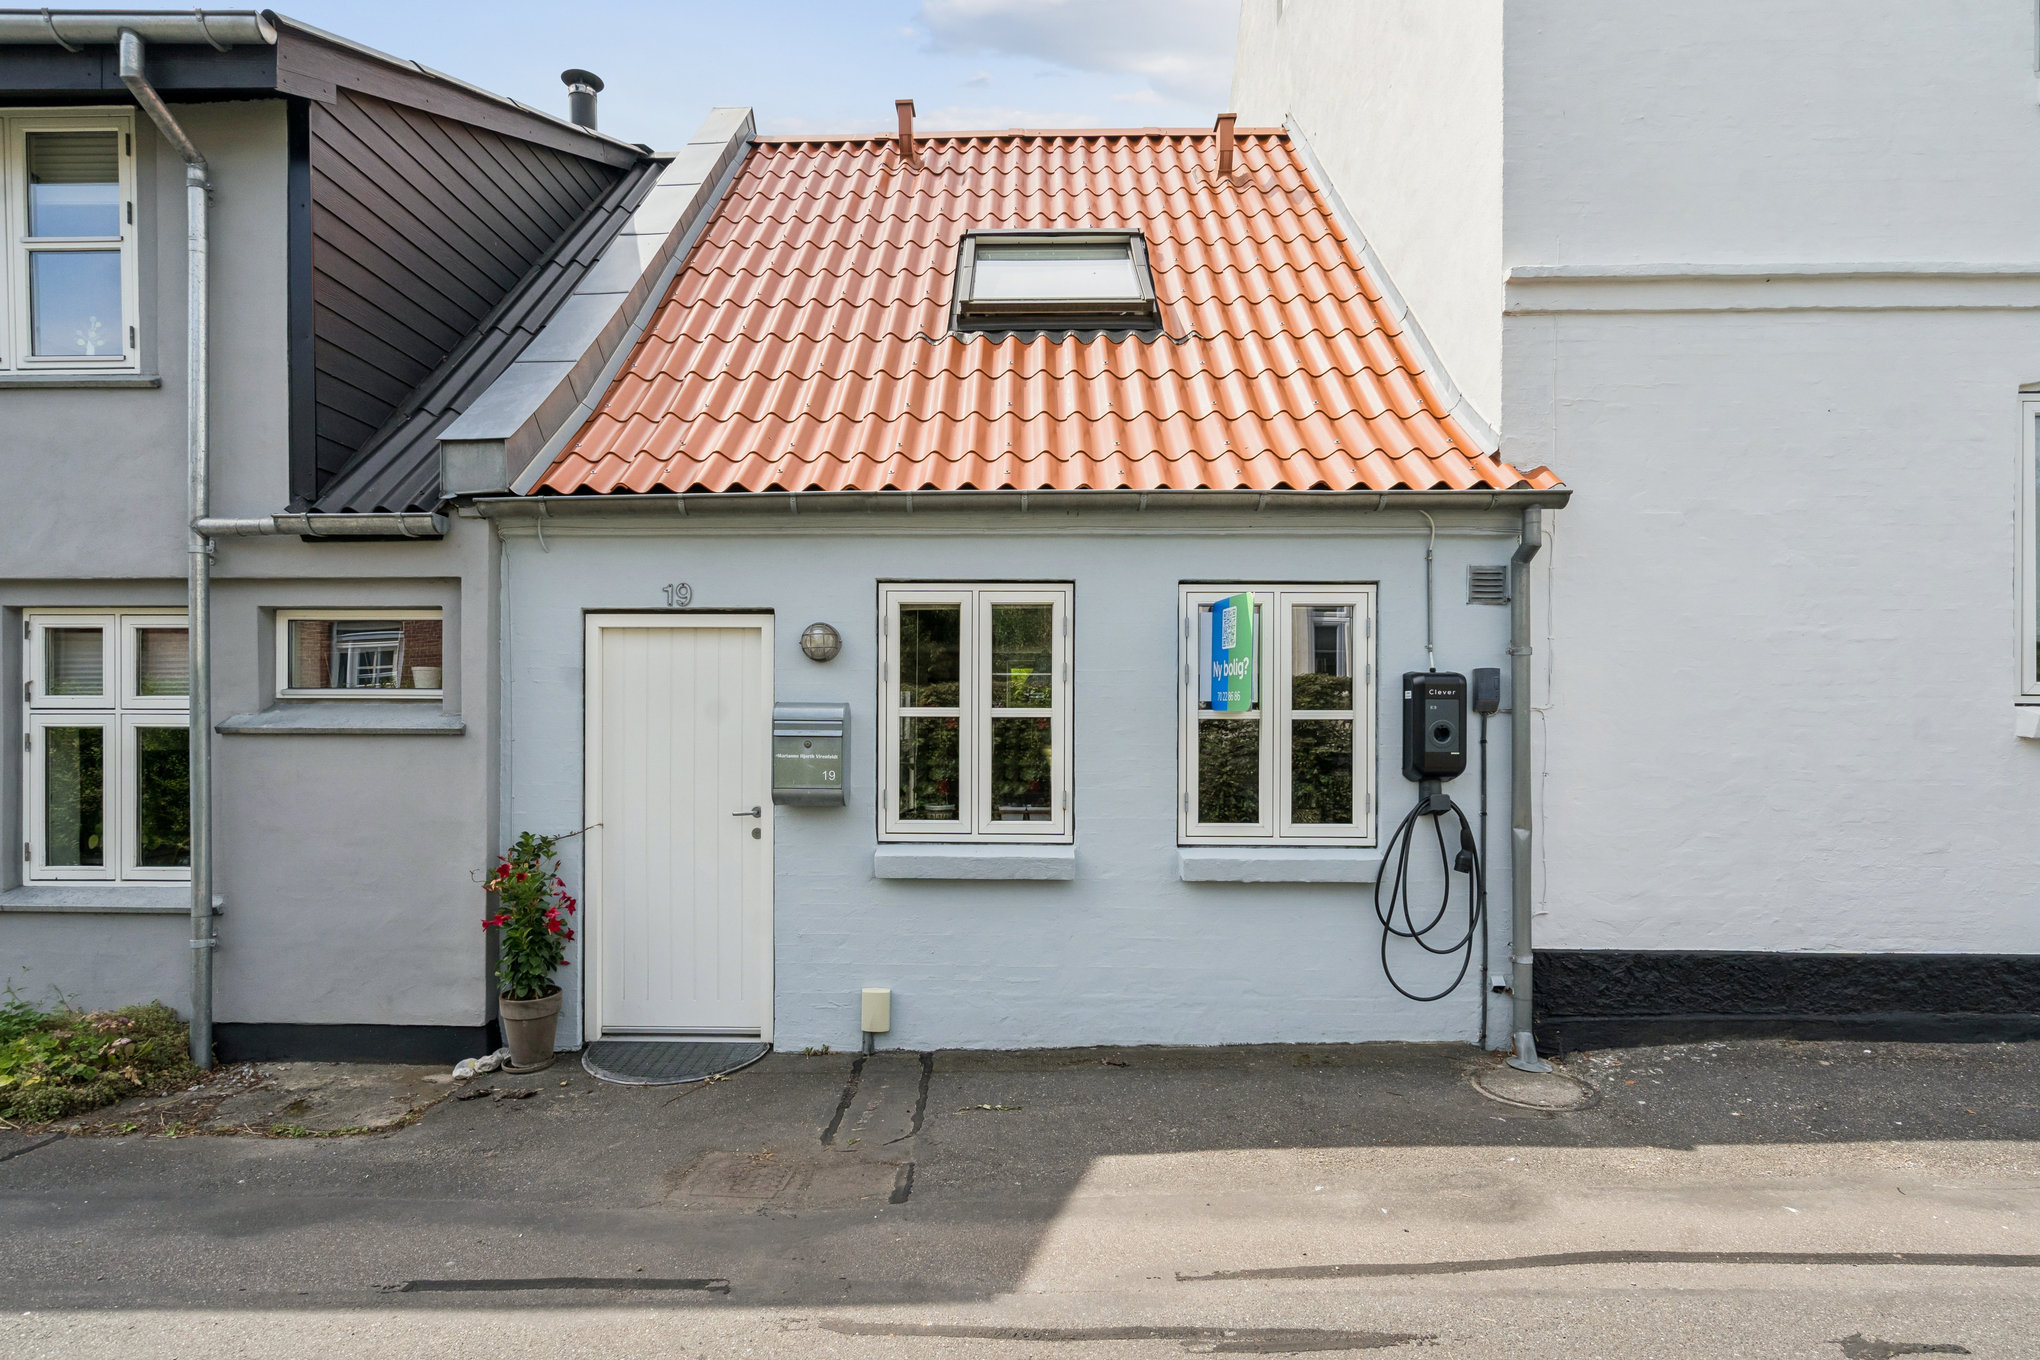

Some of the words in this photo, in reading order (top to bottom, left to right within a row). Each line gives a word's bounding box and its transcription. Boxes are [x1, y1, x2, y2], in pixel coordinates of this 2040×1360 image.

[662, 582, 693, 607] 19
[1212, 661, 1222, 681] Ny
[1223, 657, 1249, 680] bolig?
[822, 770, 836, 781] 19
